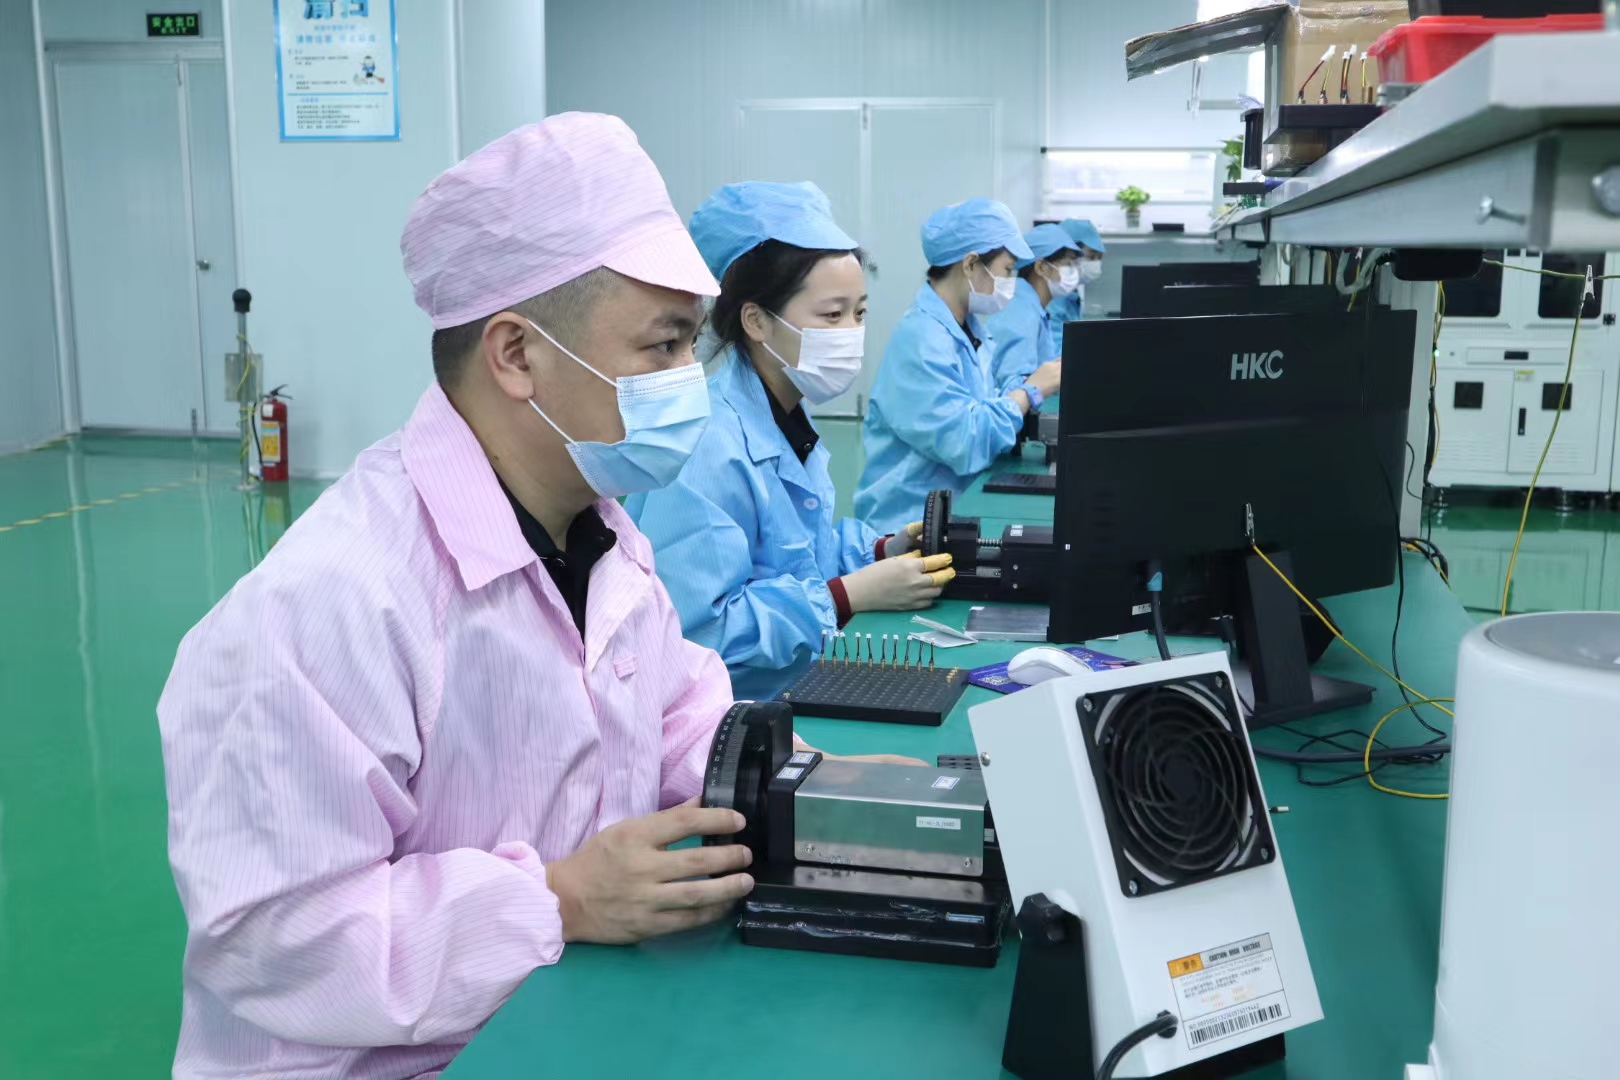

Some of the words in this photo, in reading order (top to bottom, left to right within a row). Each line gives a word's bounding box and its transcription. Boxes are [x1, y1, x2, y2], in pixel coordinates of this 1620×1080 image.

[1230, 349, 1284, 380] HKC
[1209, 952, 1227, 962] CAUTION
[1229, 947, 1240, 956] HIGH
[1242, 942, 1260, 952] VOLTAGE
